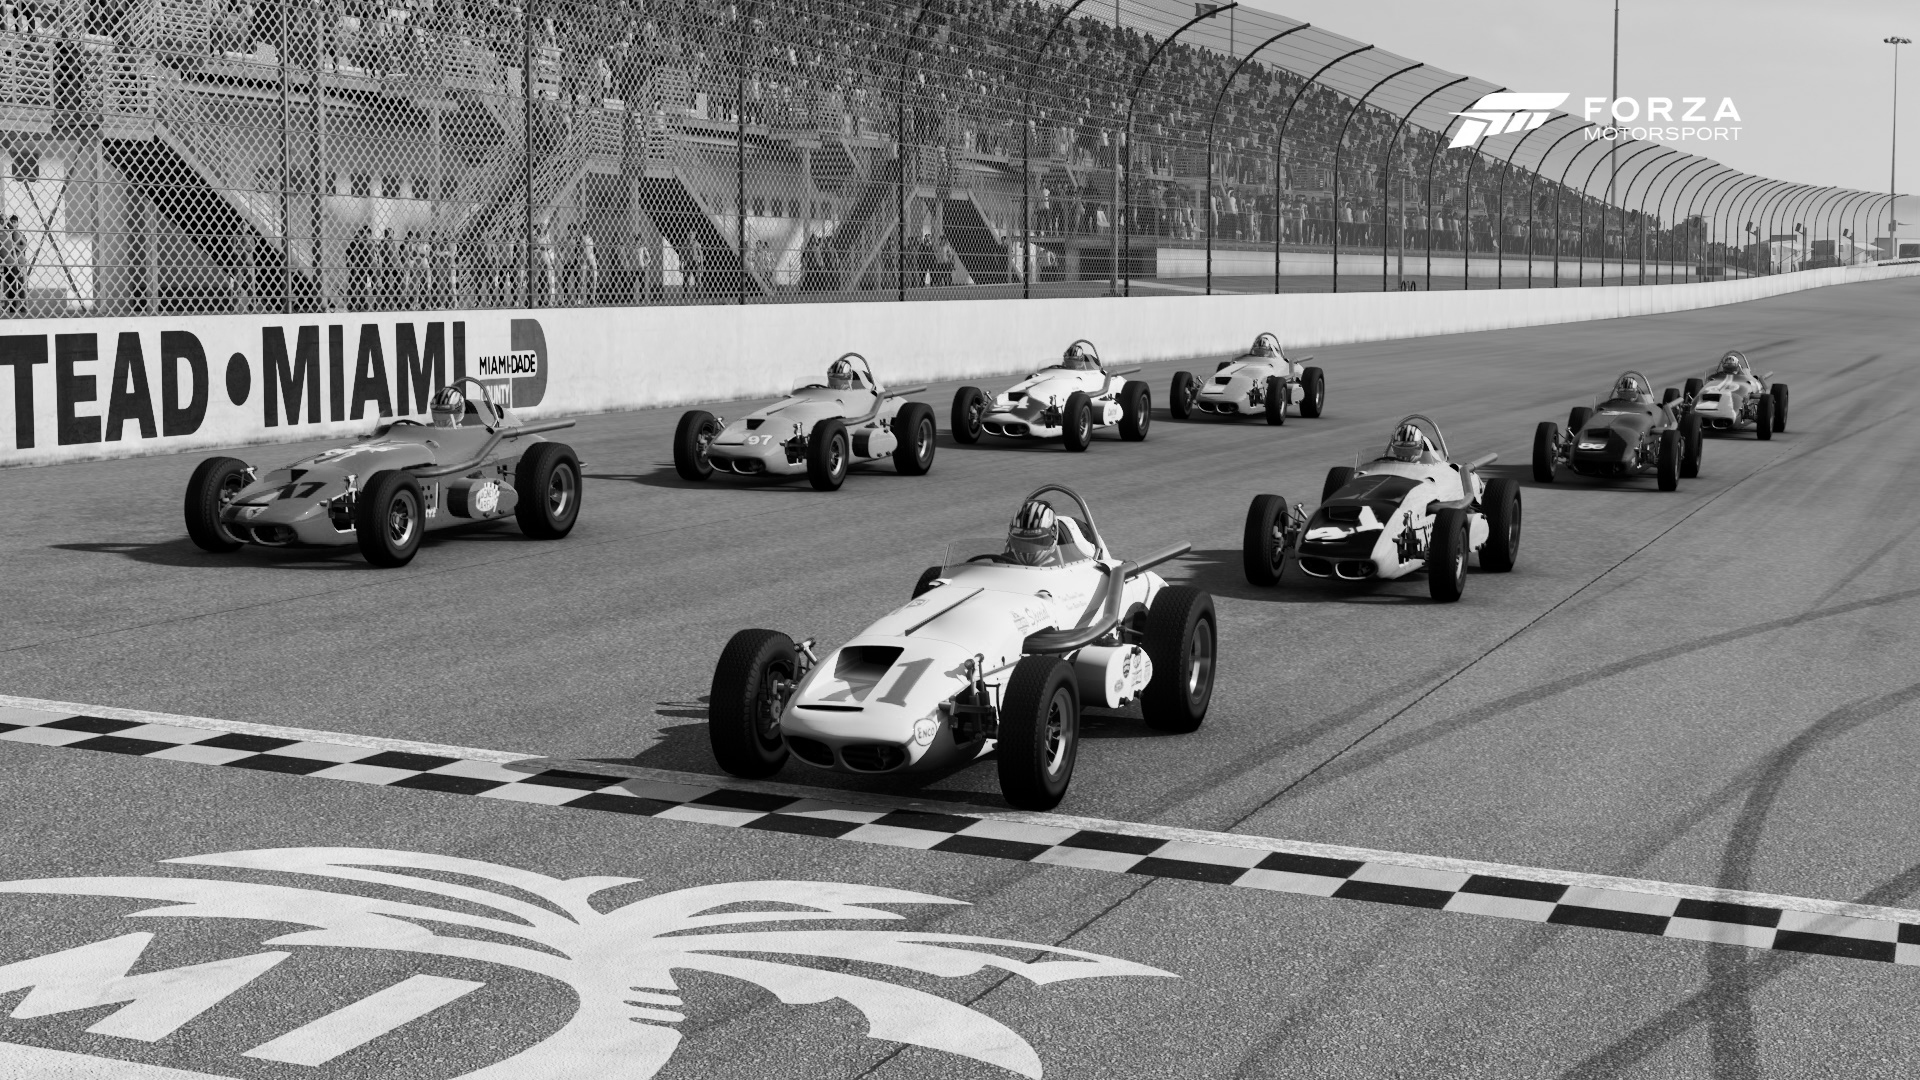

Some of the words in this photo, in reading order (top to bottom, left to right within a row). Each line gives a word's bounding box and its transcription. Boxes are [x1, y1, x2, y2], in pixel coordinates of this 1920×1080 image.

[479, 354, 536, 375] MIAMI-DADE
[0, 330, 209, 449] TEAD
[262, 321, 467, 427] MIAMI
[747, 434, 773, 446] 97
[276, 481, 328, 500] 17
